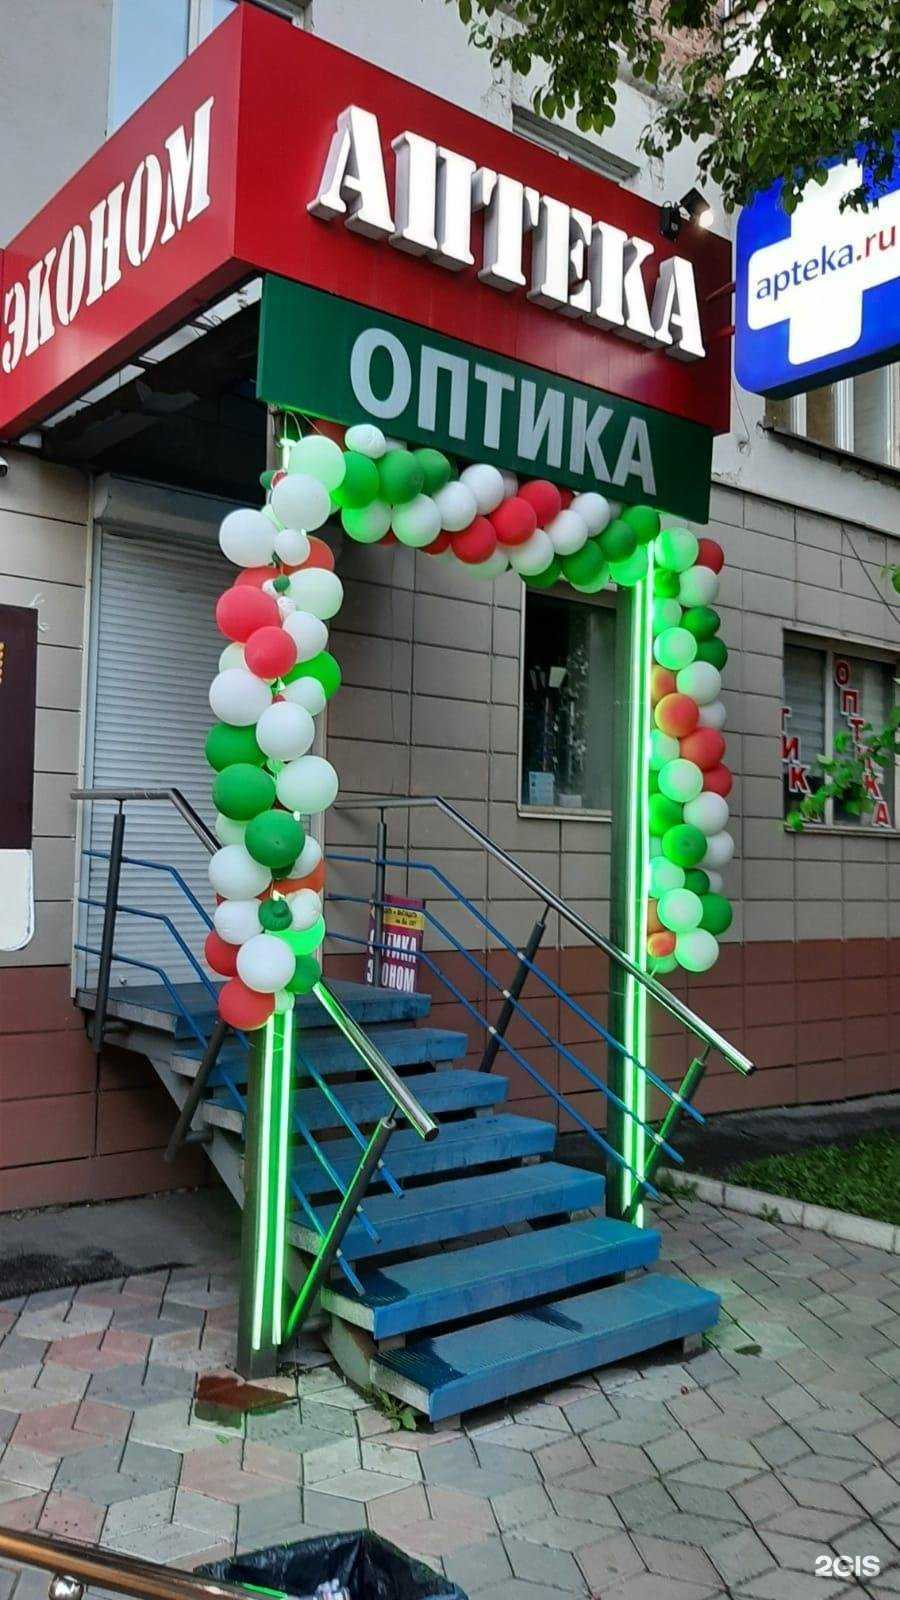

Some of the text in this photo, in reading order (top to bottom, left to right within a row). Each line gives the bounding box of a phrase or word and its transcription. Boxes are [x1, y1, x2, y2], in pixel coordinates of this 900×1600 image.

[3, 96, 215, 374] ЭКОНОМ
[306, 104, 706, 361] АПТЕКА
[756, 225, 897, 301] apteka.ru
[350, 327, 657, 496] ОПТИКА
[366, 959, 416, 993] ЭОНОМ
